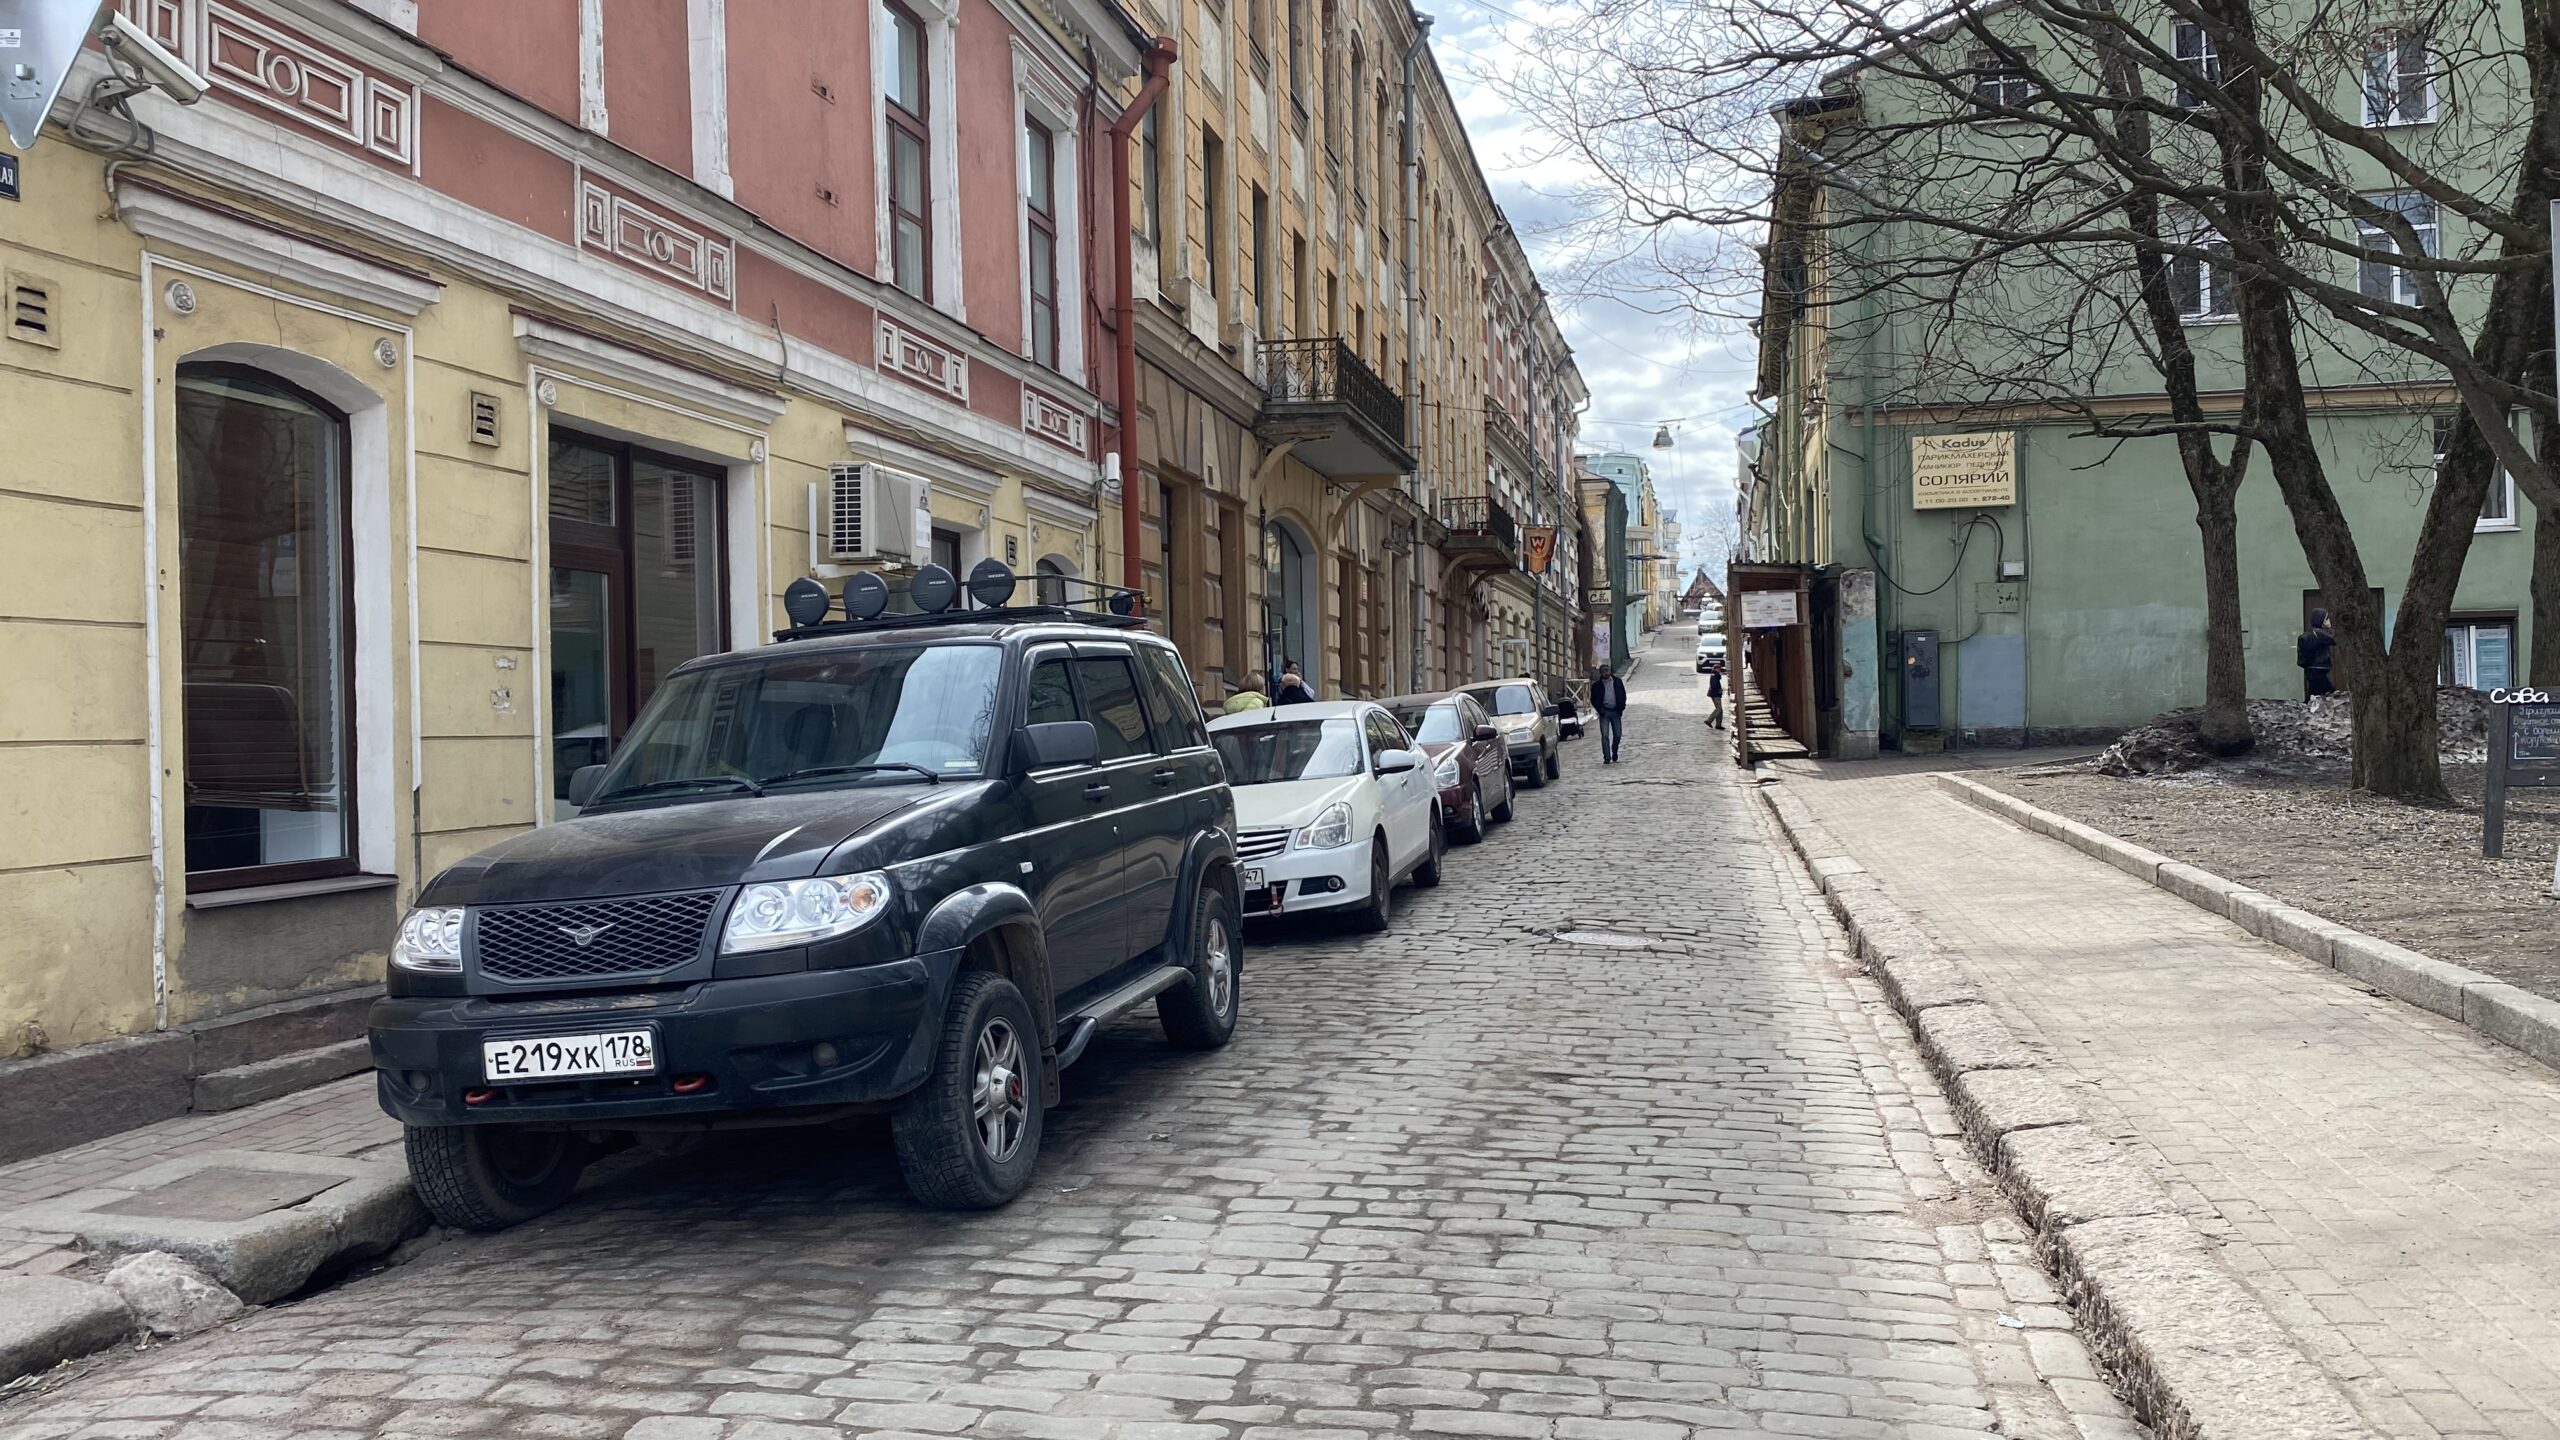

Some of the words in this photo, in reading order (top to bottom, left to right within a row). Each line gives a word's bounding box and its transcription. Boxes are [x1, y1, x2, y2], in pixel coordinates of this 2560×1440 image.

[0, 166, 14, 186] АЯ
[1942, 437, 1985, 449] Kadus
[1918, 451, 2009, 461] ПАРИКМАХЕРСКАЯ
[1919, 470, 2009, 487] СОЛЯРИЙ
[605, 1035, 645, 1060] 178
[615, 1058, 636, 1068] RUS
